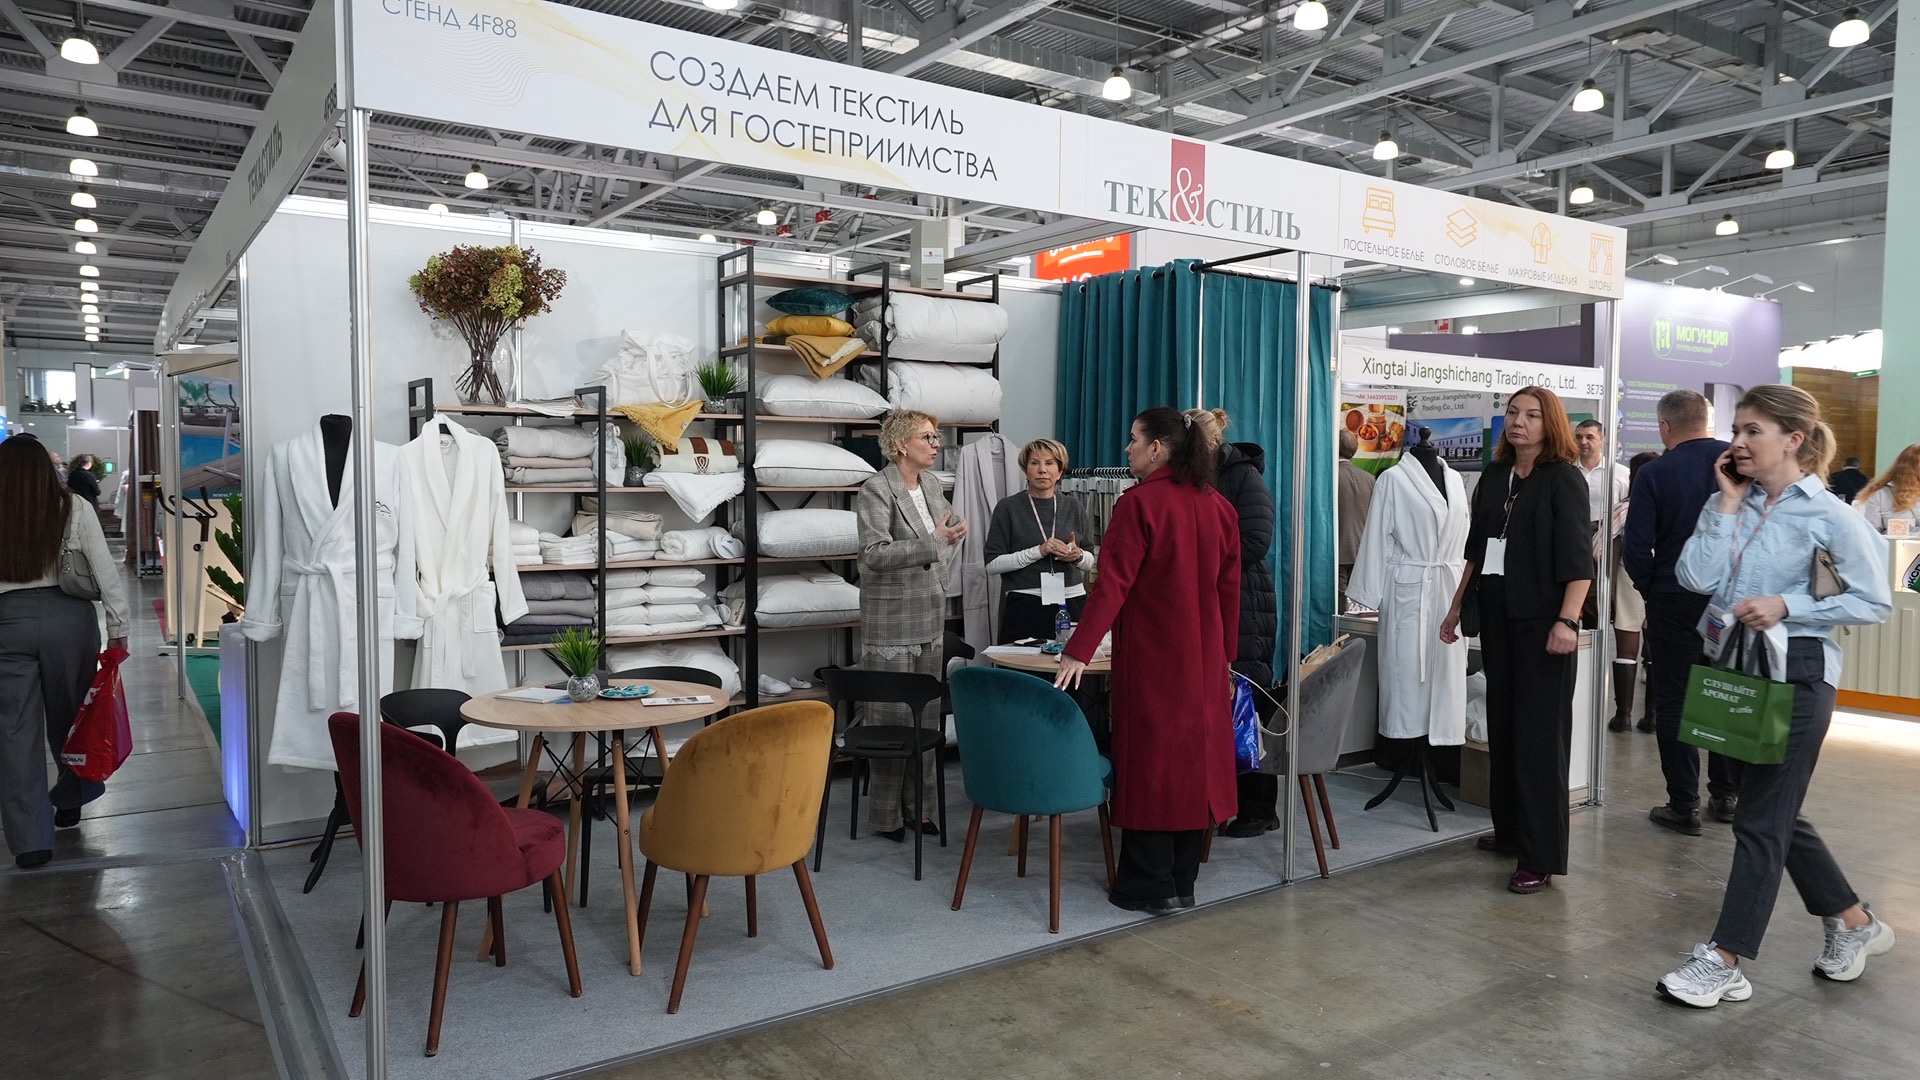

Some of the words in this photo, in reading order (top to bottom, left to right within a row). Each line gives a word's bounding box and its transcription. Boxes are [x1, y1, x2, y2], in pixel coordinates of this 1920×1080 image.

[382, 0, 461, 30] СТЕНД
[468, 13, 517, 38] 4F88
[650, 50, 819, 110] СОЗДАЕМ
[829, 85, 964, 135] ТЕКСТИЛЬ
[648, 97, 717, 136] ДЛЯ
[730, 110, 998, 182] ГОСТЕПРИИМСТВА
[1103, 166, 1302, 241] ТЕК&СТИЛЬ
[1343, 238, 1399, 258] ПОСТЕЛЬНОЕ
[1401, 248, 1425, 262] БЕЛЬЕ
[1434, 253, 1476, 271] СТОЛОВОЕ
[1477, 260, 1500, 275] БЕЛЬЕ
[1507, 266, 1547, 282] МАХРОВЫЕ
[1547, 272, 1578, 286] ИЗДЕЛИЯ
[1588, 279, 1612, 292] ШТОРЫ
[1676, 325, 1729, 348] МОГУНЦИЯ
[1362, 357, 1407, 380] Xingtai
[1410, 361, 1492, 388] Jiangshichang
[1495, 369, 1534, 388] Trading
[1537, 373, 1556, 391] Co.,
[1558, 374, 1577, 390] Ltd.
[1442, 393, 1482, 401] Jiangshichang
[1586, 383, 1604, 396] 3E73
[1422, 404, 1441, 412] Trading
